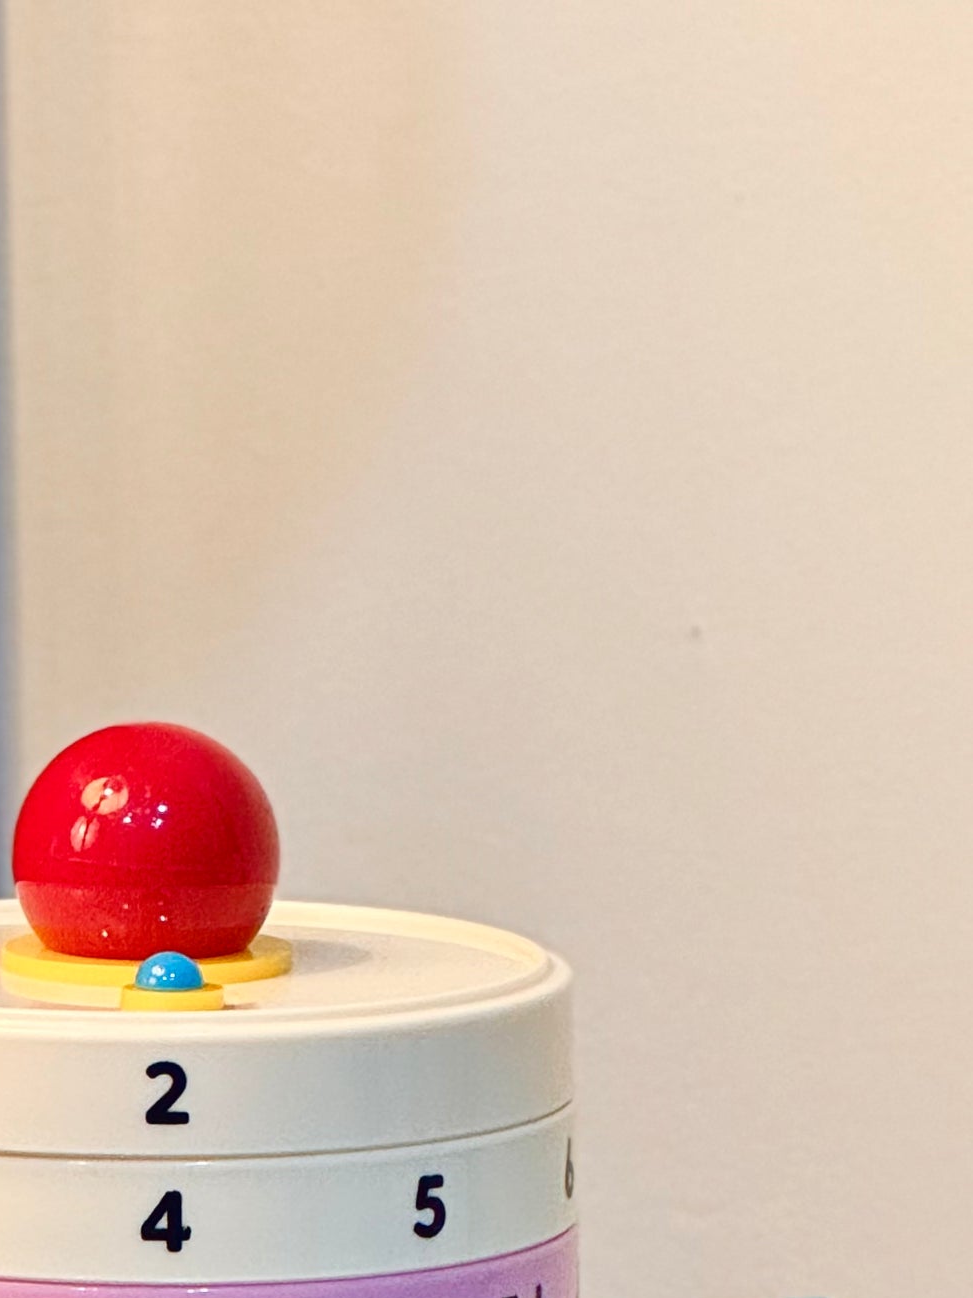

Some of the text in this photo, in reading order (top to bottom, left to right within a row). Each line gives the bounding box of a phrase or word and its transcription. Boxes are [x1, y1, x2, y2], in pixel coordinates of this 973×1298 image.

[145, 1060, 190, 1126] 2
[140, 1190, 192, 1253] 4
[413, 1174, 447, 1239] 5
